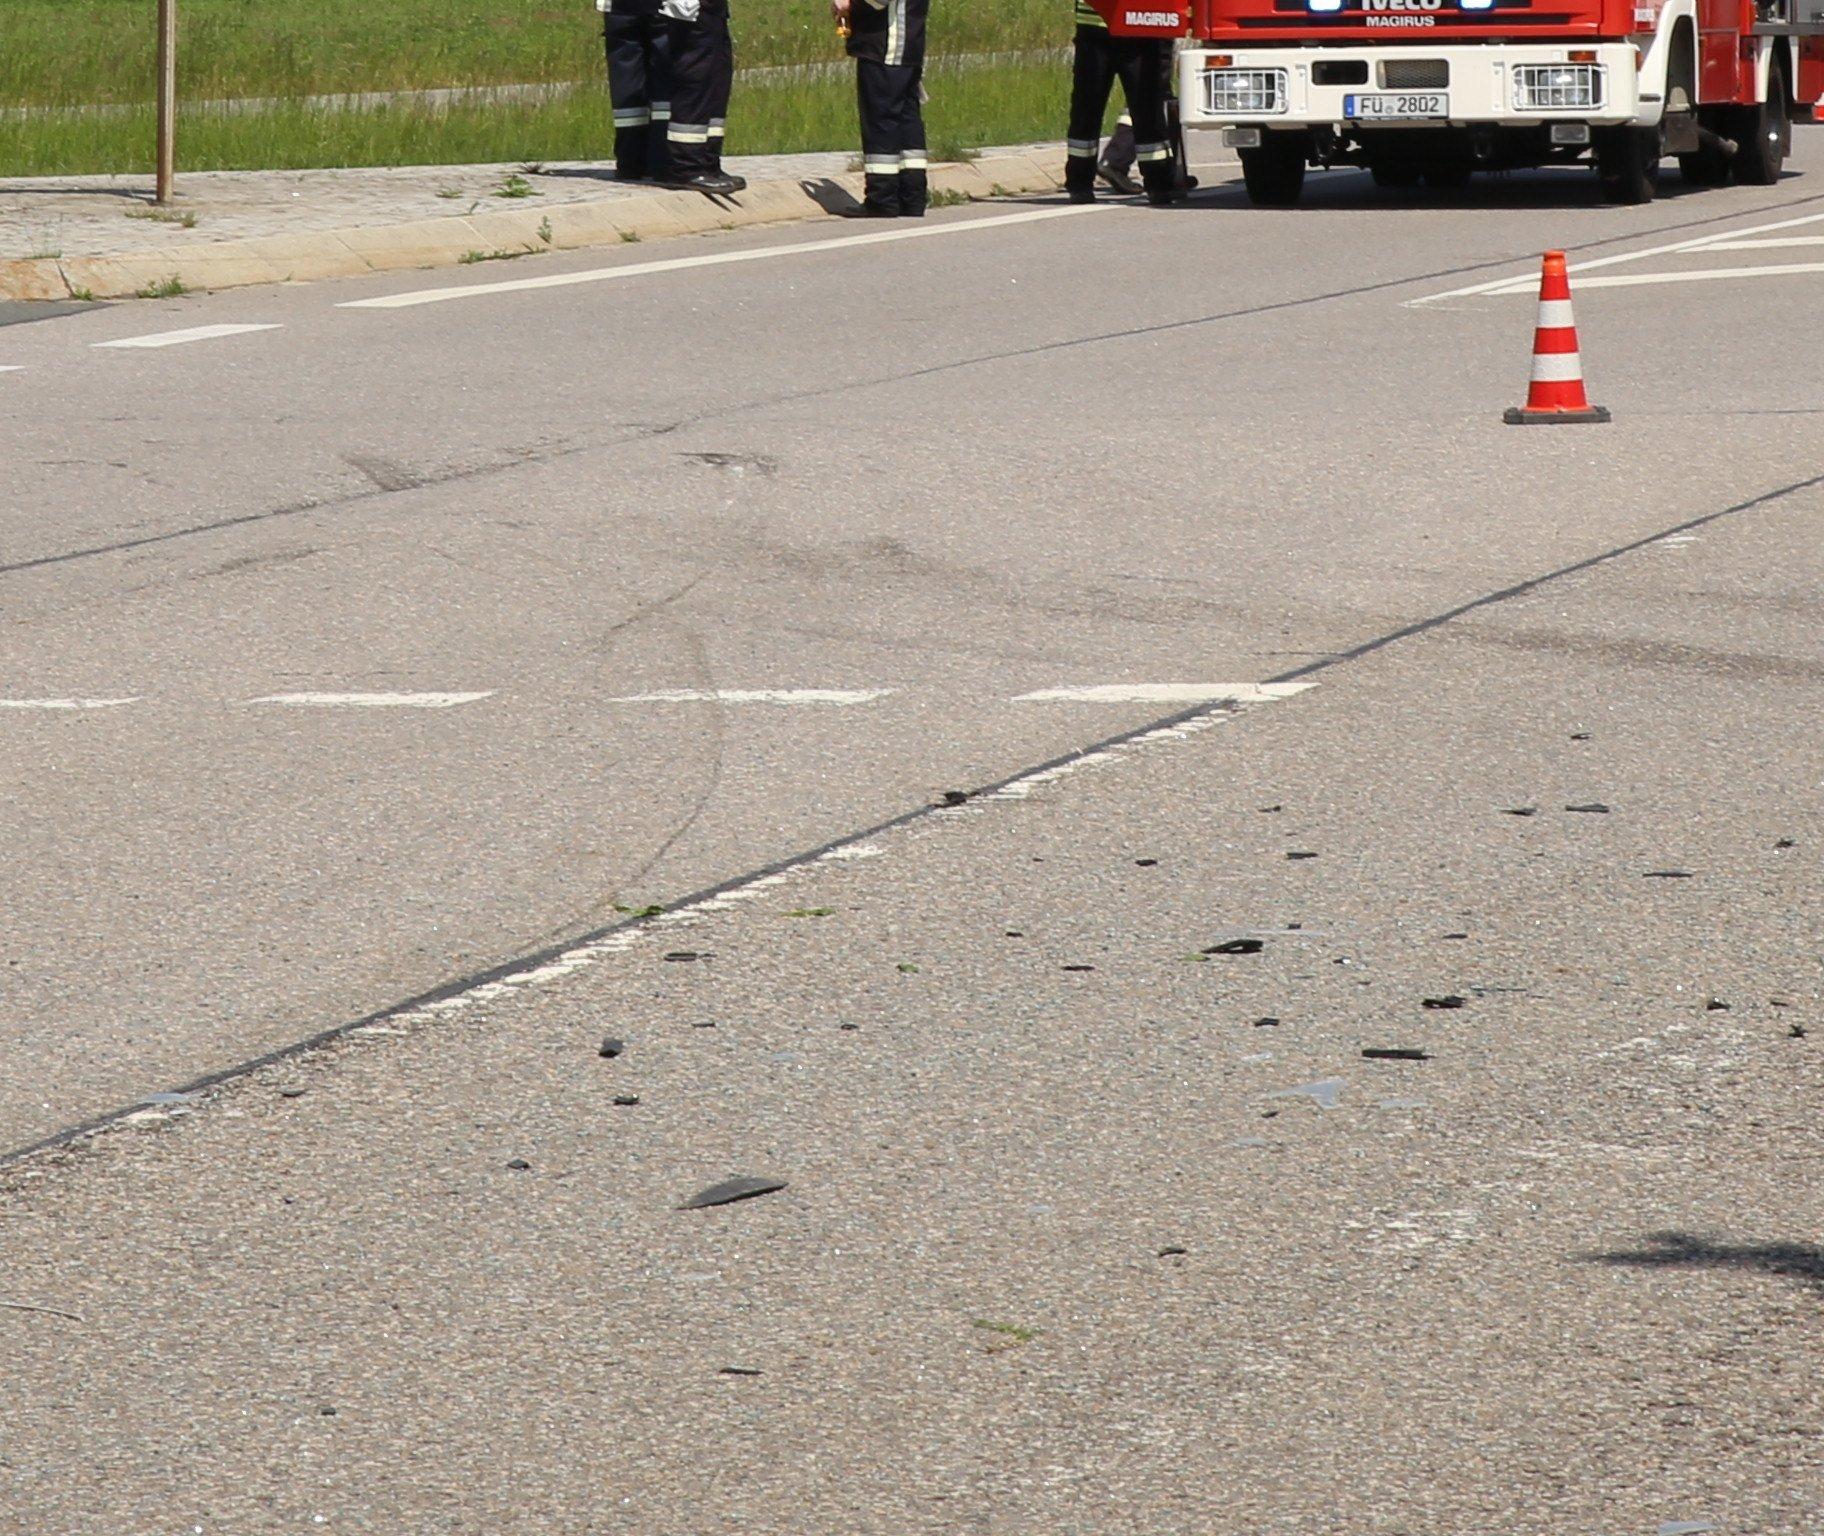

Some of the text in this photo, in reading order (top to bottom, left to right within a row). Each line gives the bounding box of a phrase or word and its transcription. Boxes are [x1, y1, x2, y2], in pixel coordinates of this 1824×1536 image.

[1125, 11, 1180, 27] MAGIRUS
[1366, 15, 1436, 27] MAGIRUS
[1360, 96, 1440, 113] FÜ 2802
